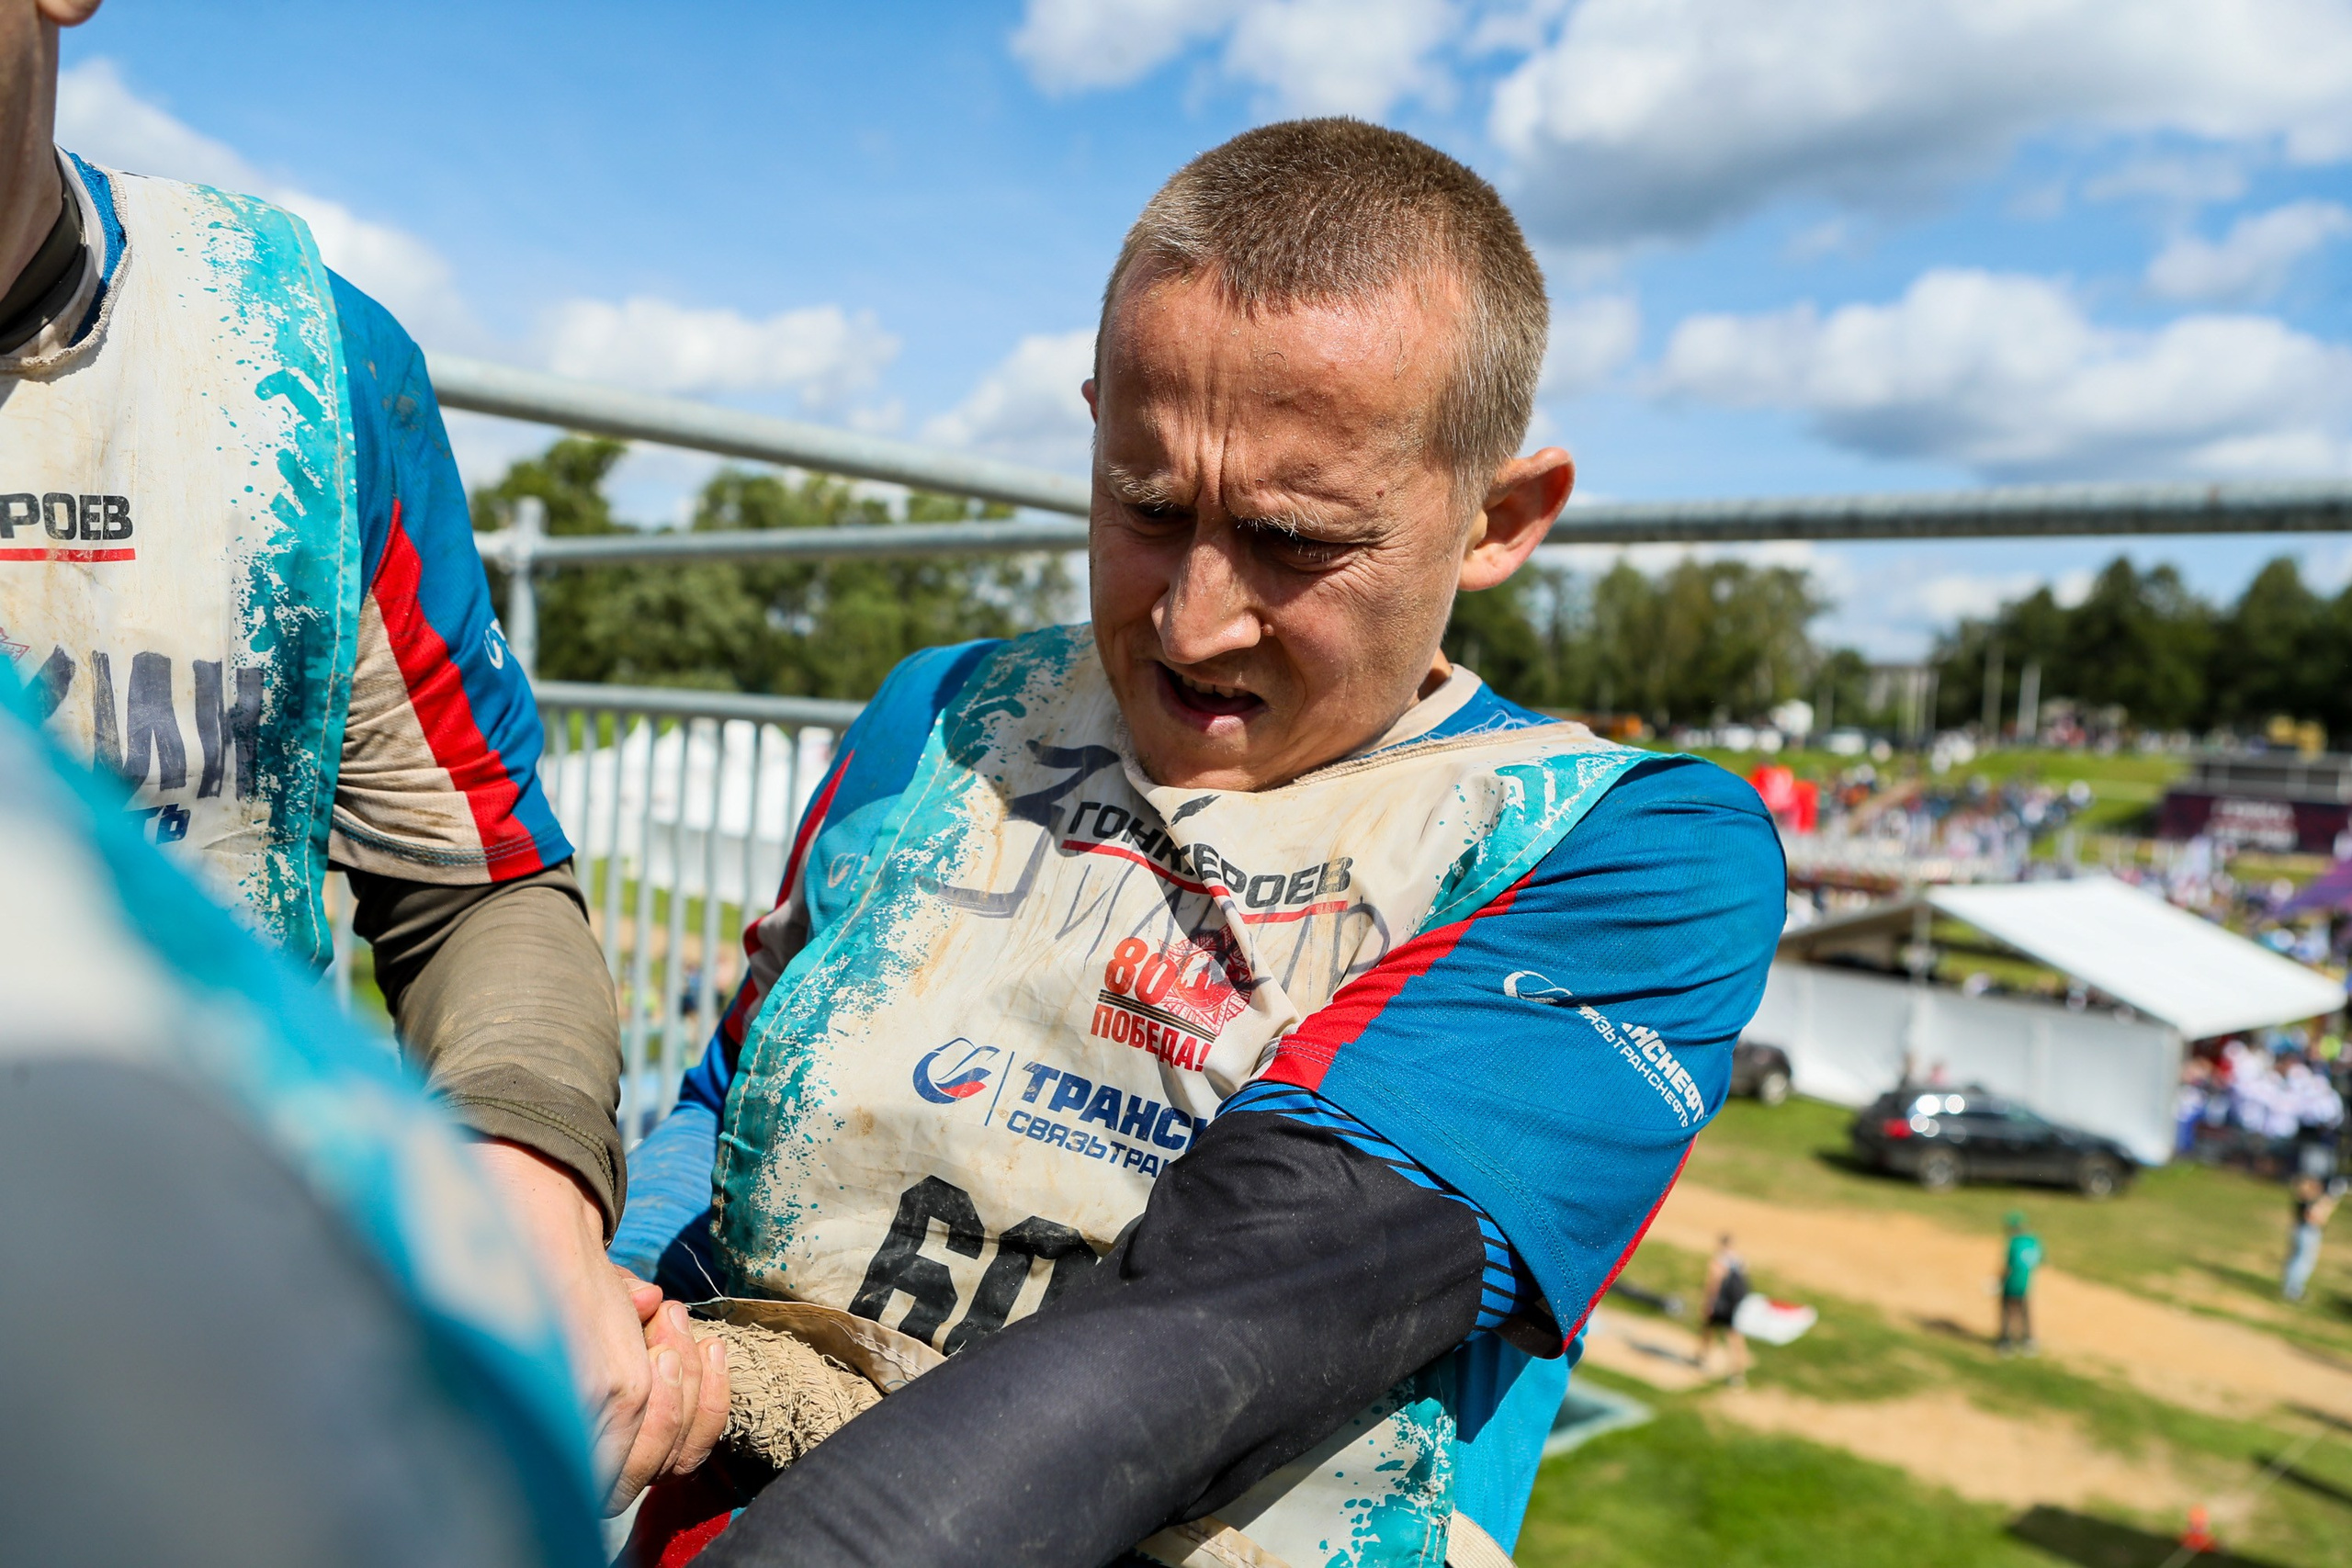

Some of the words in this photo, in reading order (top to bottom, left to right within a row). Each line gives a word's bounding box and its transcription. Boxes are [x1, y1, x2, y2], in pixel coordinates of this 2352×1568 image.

[1068, 801, 1195, 876] ГОНК
[1180, 842, 1353, 909] ЕРОЕВ
[1104, 936, 1181, 1006] 80
[1091, 1003, 1212, 1073] ПОБЕДА!
